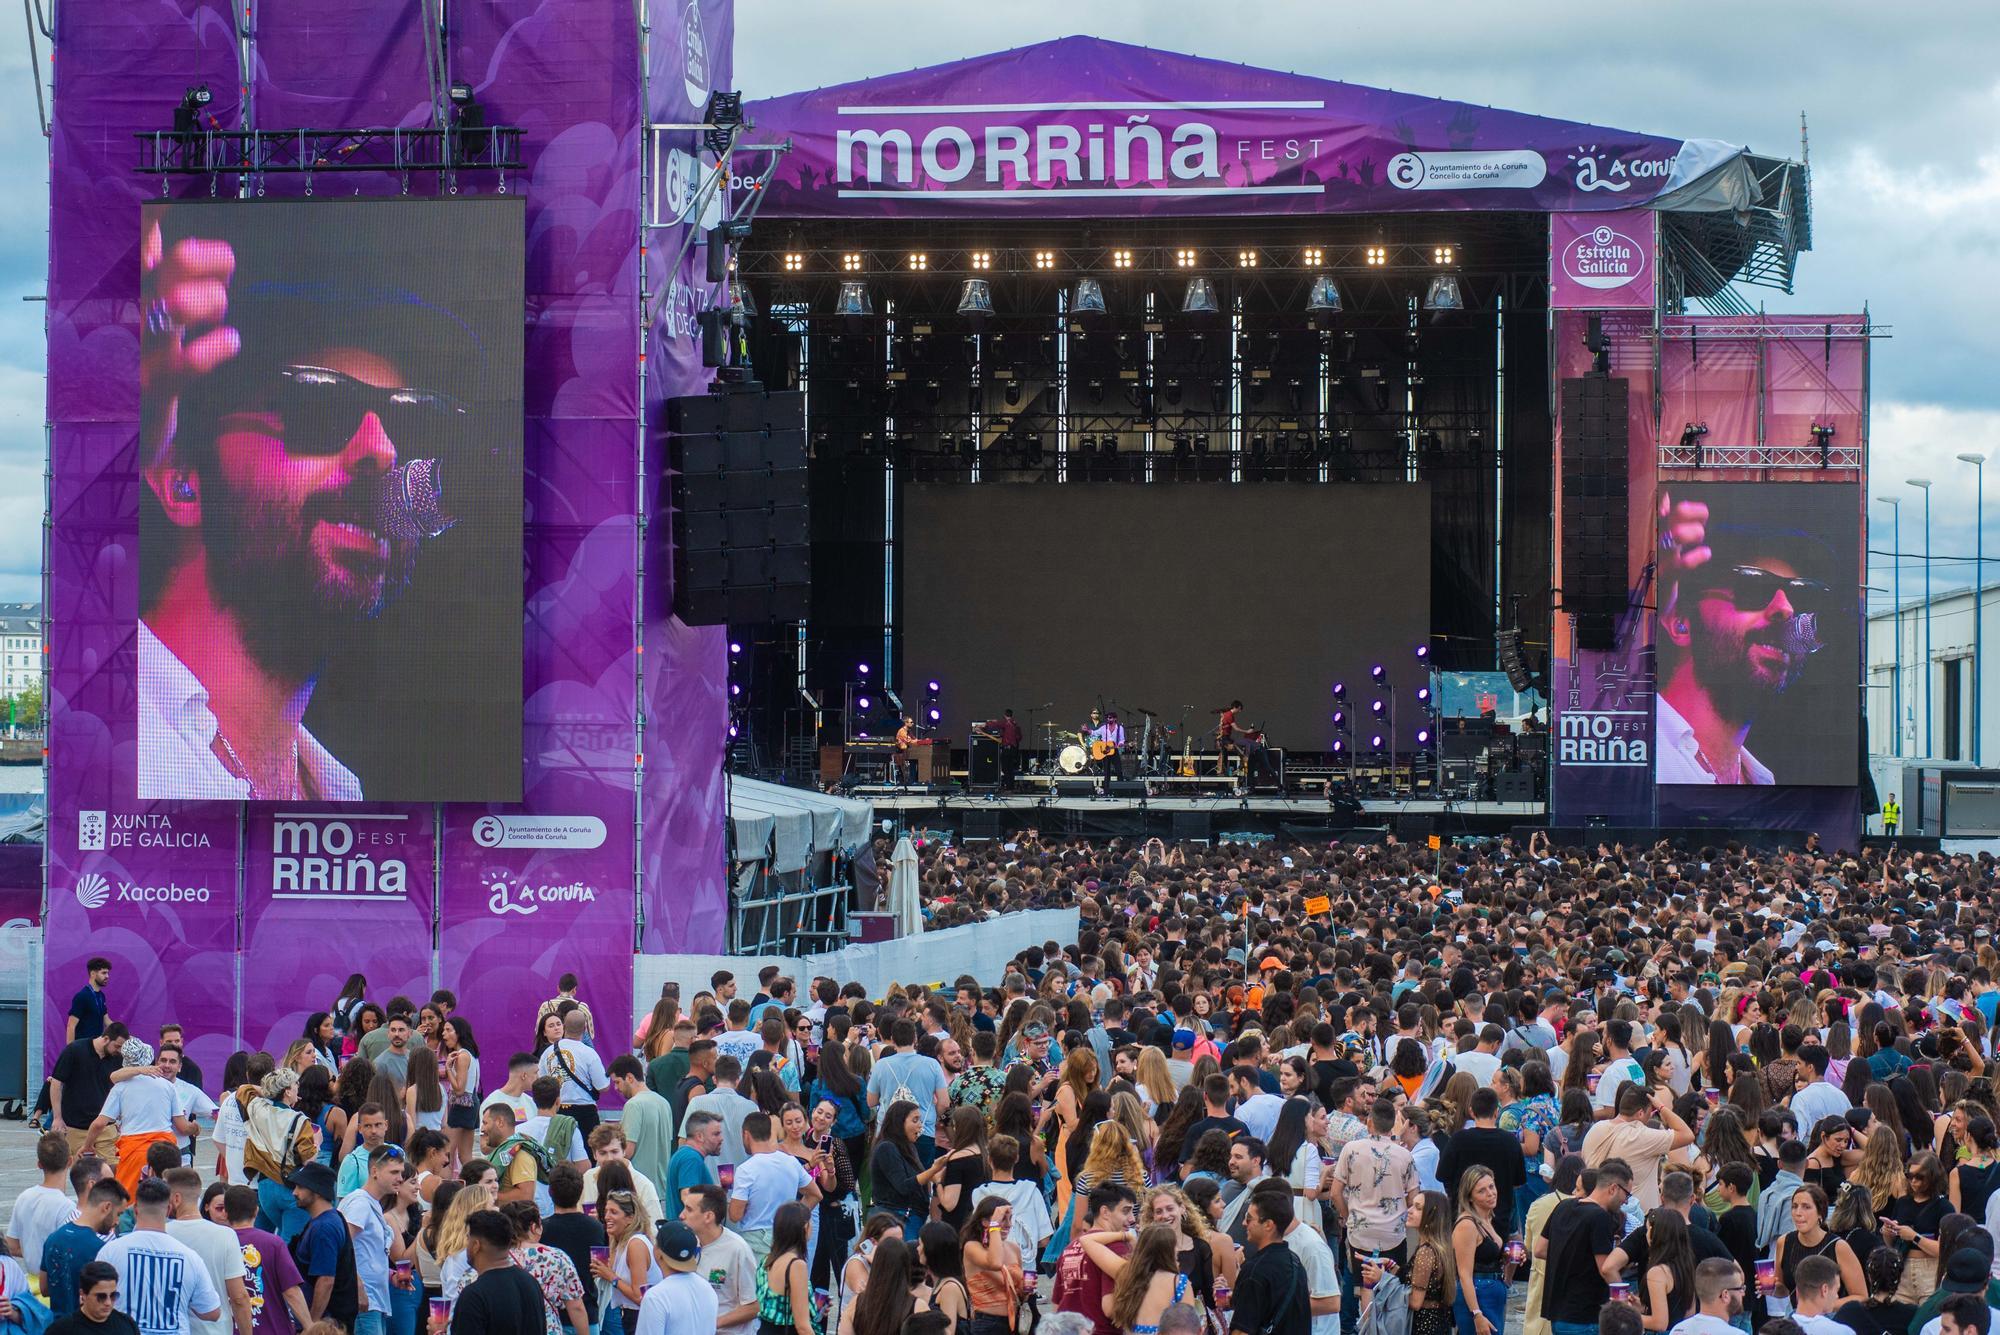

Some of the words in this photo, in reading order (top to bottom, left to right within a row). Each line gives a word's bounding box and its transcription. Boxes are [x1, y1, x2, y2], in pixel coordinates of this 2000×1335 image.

[1238, 139, 1325, 161] FEST
[1429, 164, 1481, 173] Ayuntamiento
[1482, 163, 1492, 171] de
[1501, 162, 1528, 170] Coruña
[1608, 159, 1627, 178] A
[1429, 172, 1461, 180] Concello
[1576, 245, 1631, 259] Estrella
[1578, 259, 1628, 273] Galicia
[1614, 722, 1648, 731] FEST
[112, 814, 172, 829] XUNTA
[508, 826, 552, 834] Ayuntamiento
[110, 832, 132, 847] DE
[138, 832, 211, 848] GALICIA
[357, 832, 407, 846] FEST
[116, 882, 210, 902] Xacobeo
[519, 884, 535, 901] A
[129, 1252, 184, 1330] VANS
